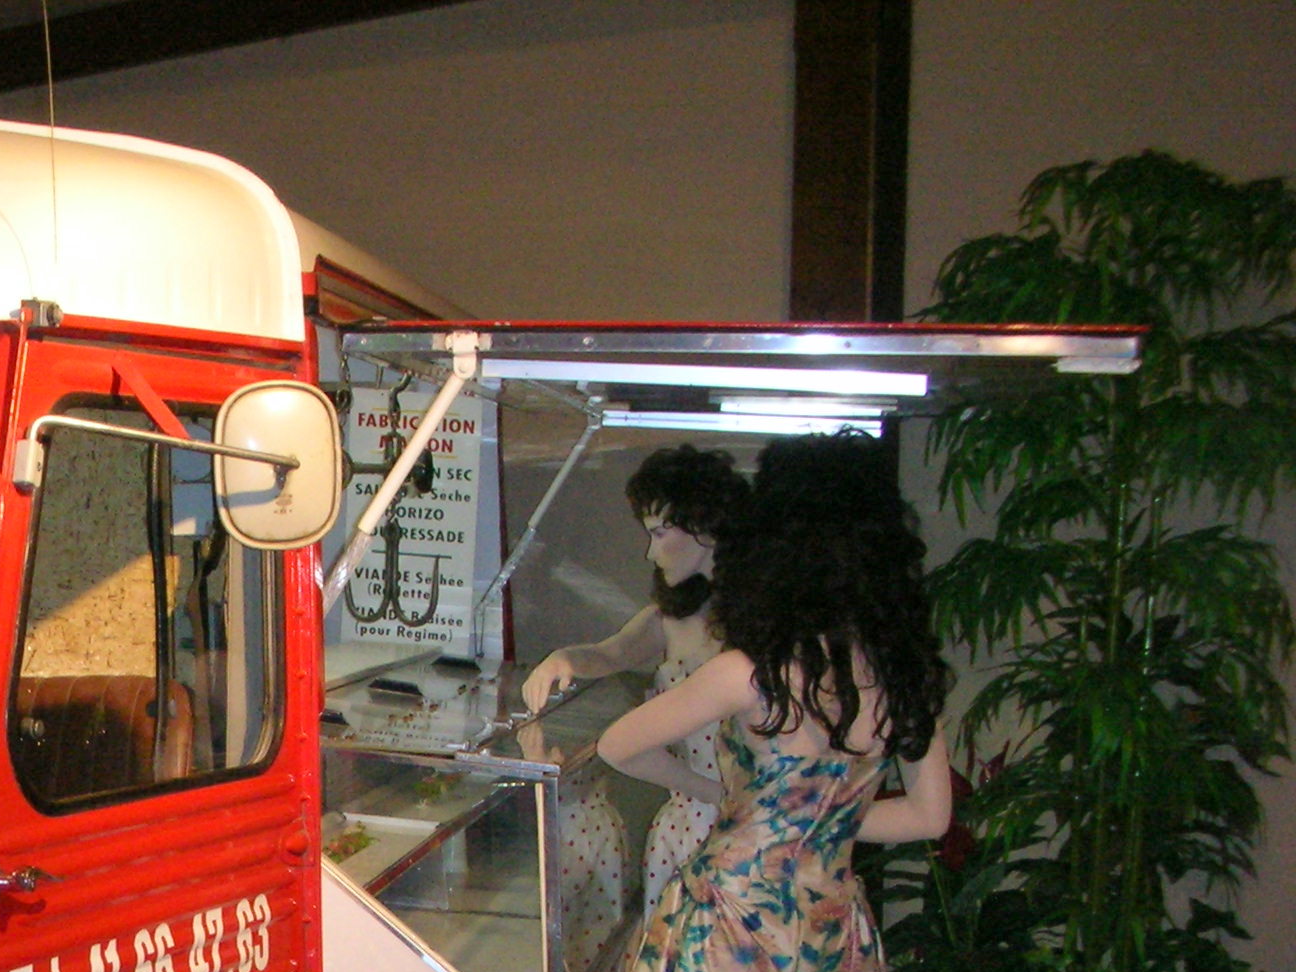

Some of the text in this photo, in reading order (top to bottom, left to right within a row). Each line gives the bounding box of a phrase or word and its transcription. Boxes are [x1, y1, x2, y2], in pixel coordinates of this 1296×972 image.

[358, 413, 475, 434] FABRICION
[379, 435, 453, 453] MAON
[447, 468, 472, 481] SEC
[385, 506, 444, 521] ORIZO
[355, 606, 405, 621] IAD
